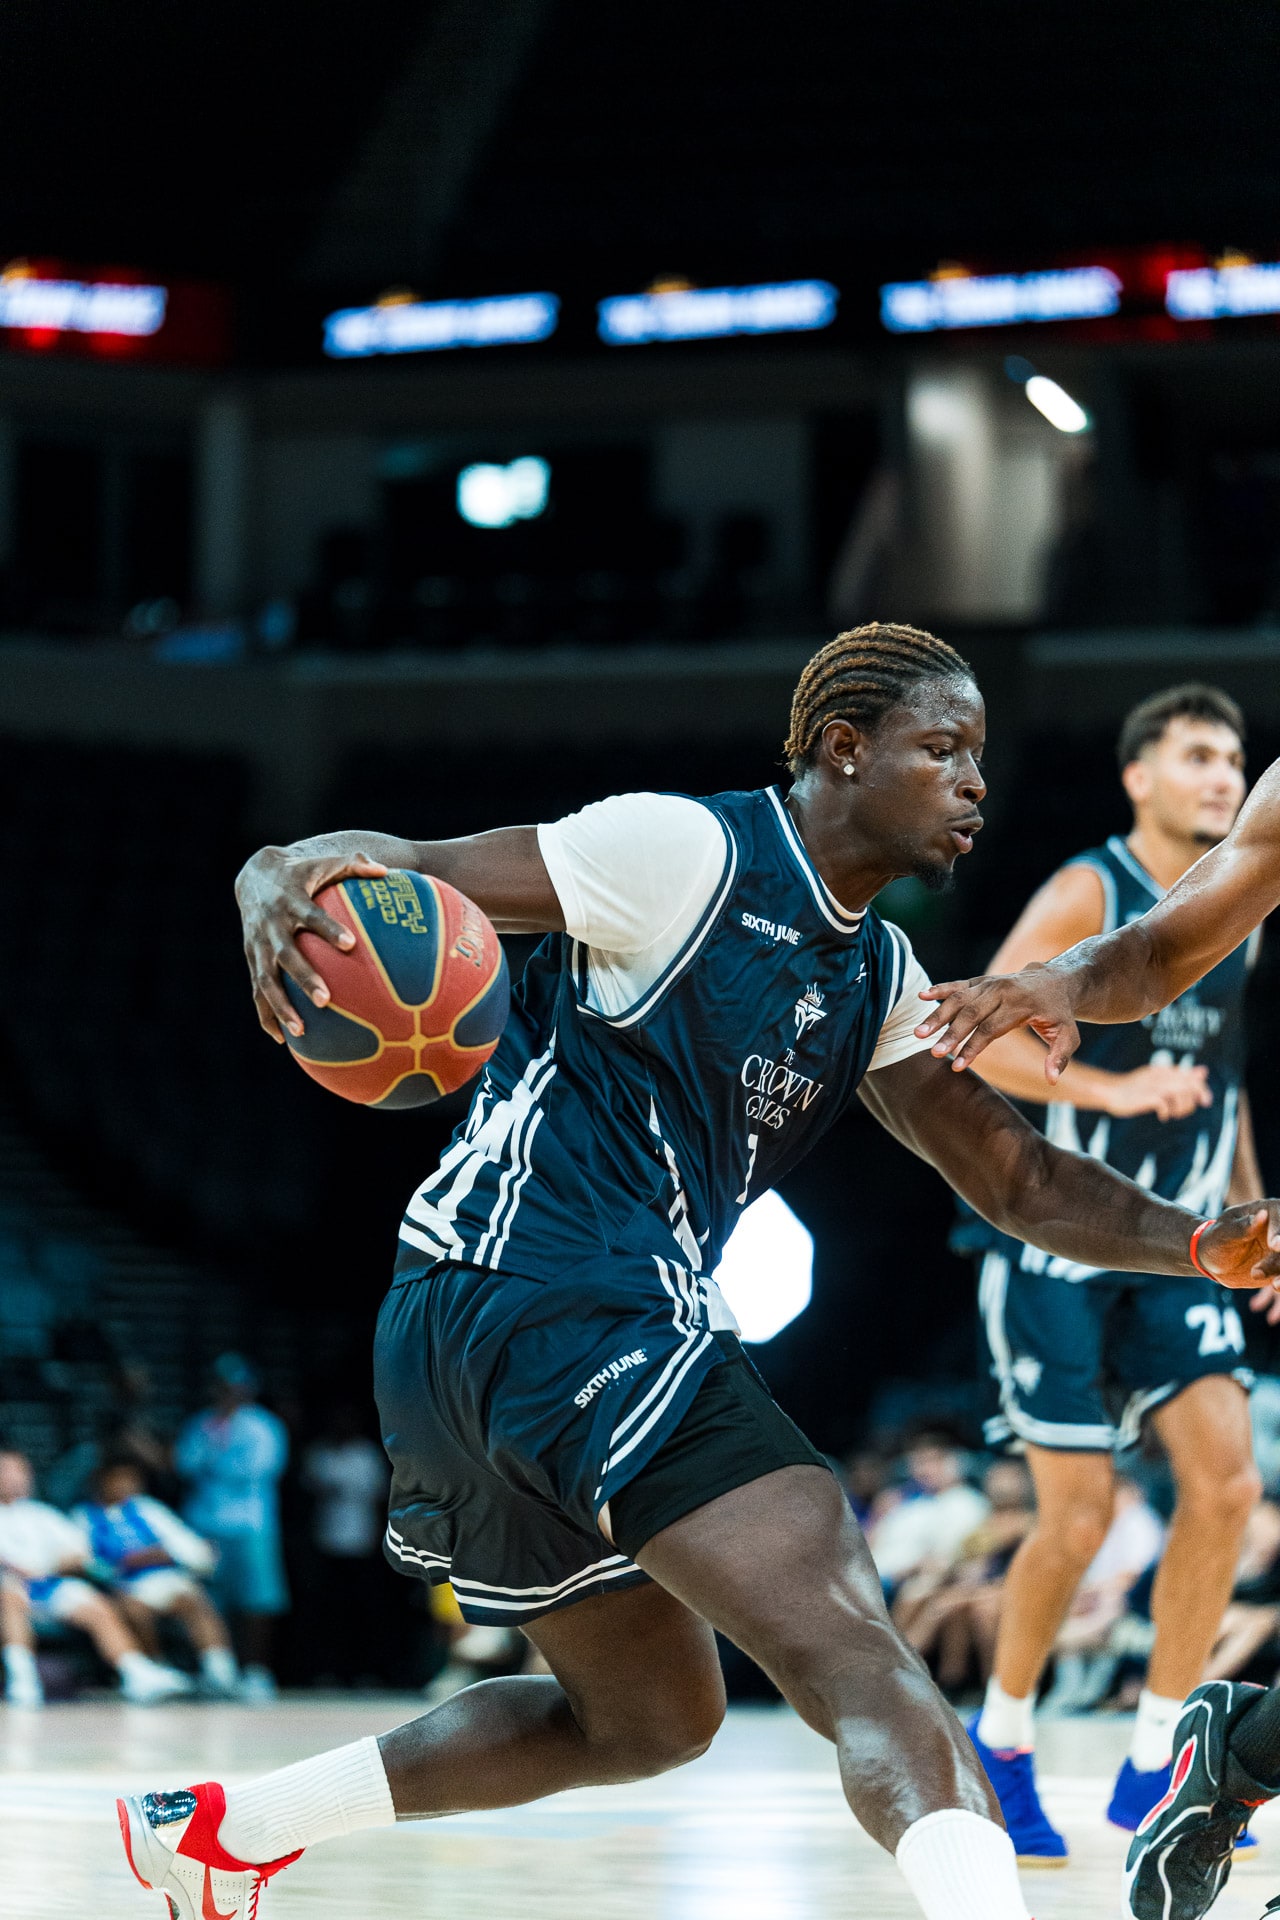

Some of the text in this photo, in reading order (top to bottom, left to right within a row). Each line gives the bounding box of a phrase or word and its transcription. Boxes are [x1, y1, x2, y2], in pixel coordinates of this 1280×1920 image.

[741, 912, 801, 945] SIXTH JUNE
[784, 1048, 796, 1066] TE
[1184, 1303, 1247, 1358] 24
[574, 1349, 648, 1409] SIXTH JUNE
